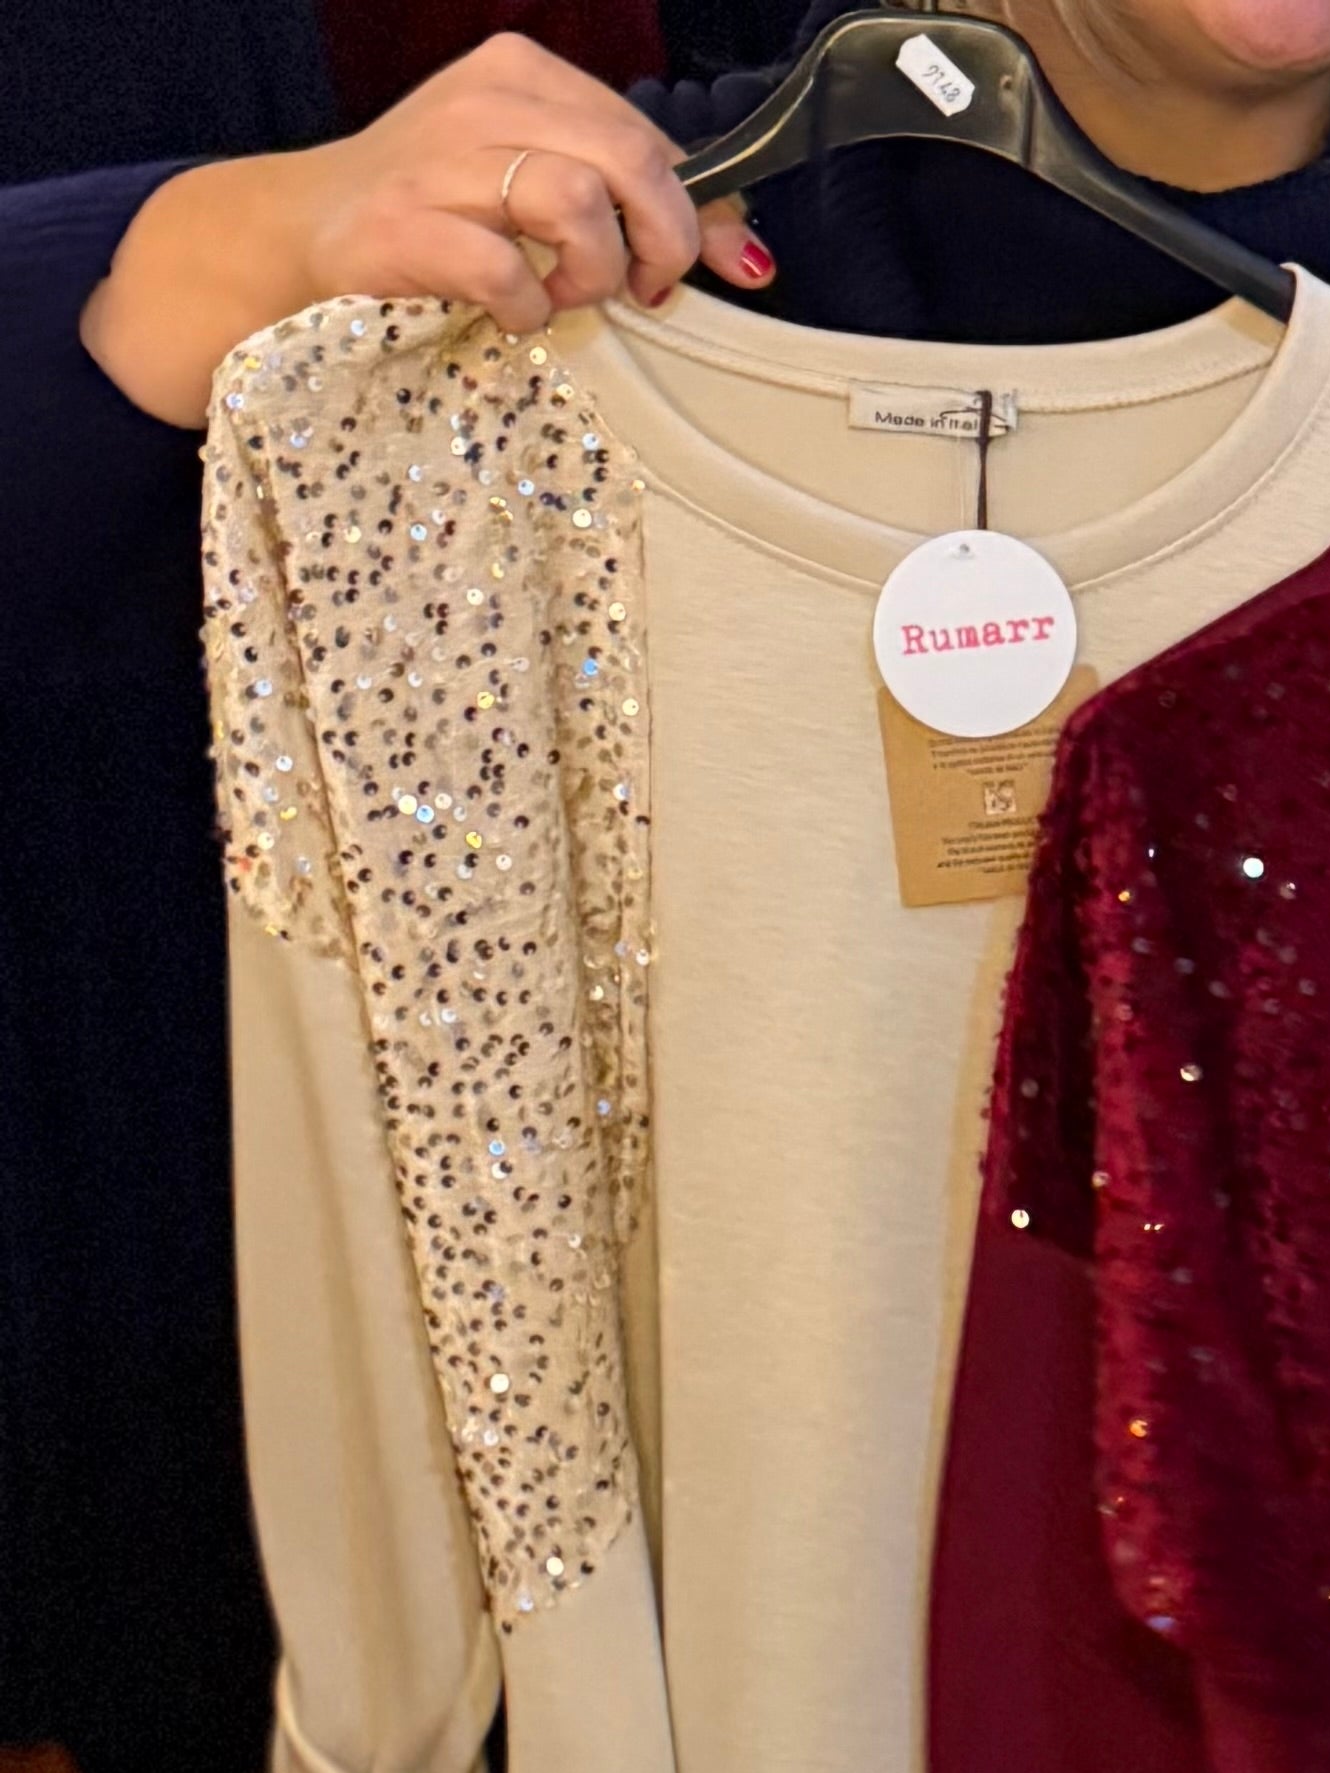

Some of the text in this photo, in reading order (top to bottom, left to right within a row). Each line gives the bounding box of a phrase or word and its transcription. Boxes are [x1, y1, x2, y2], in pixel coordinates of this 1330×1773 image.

[875, 411, 979, 431] Made in Ital
[901, 615, 1055, 656] Rumarr
